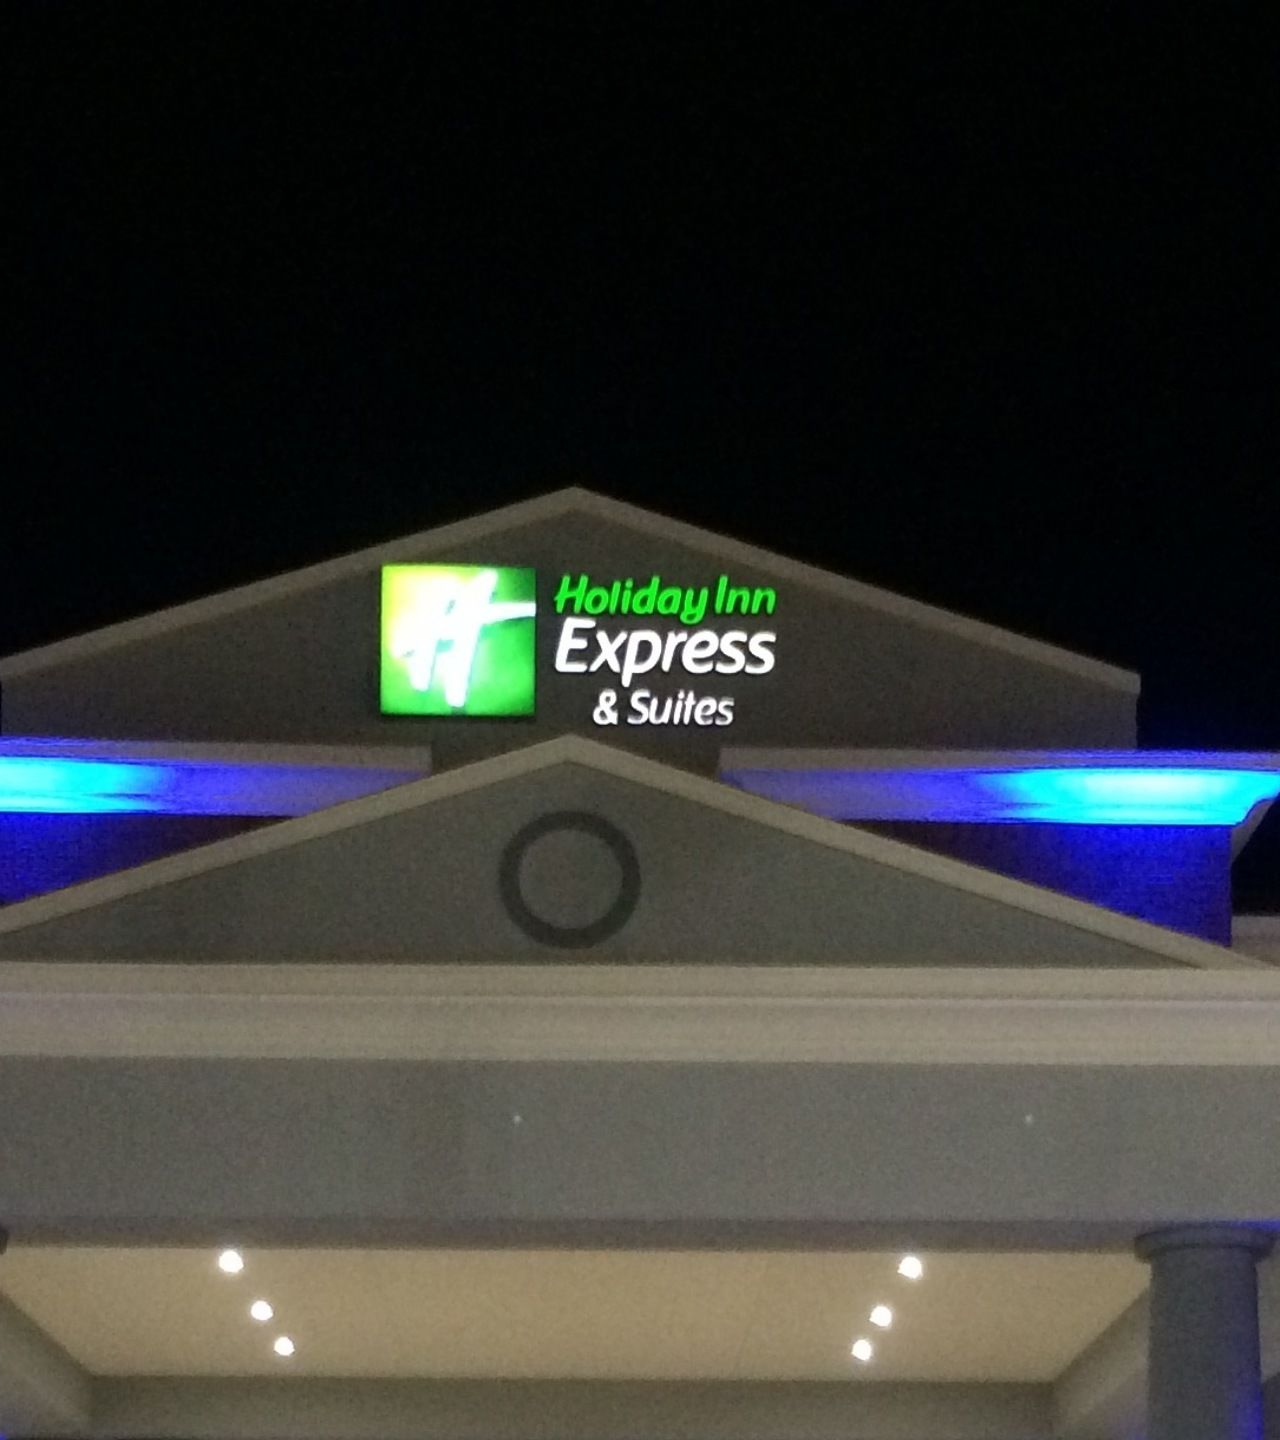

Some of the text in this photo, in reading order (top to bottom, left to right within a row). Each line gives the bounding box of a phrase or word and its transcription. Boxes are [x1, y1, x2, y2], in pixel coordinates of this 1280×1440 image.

[554, 574, 777, 625] Holiday Inn
[554, 616, 777, 688] Express
[592, 688, 735, 726] & Suites
